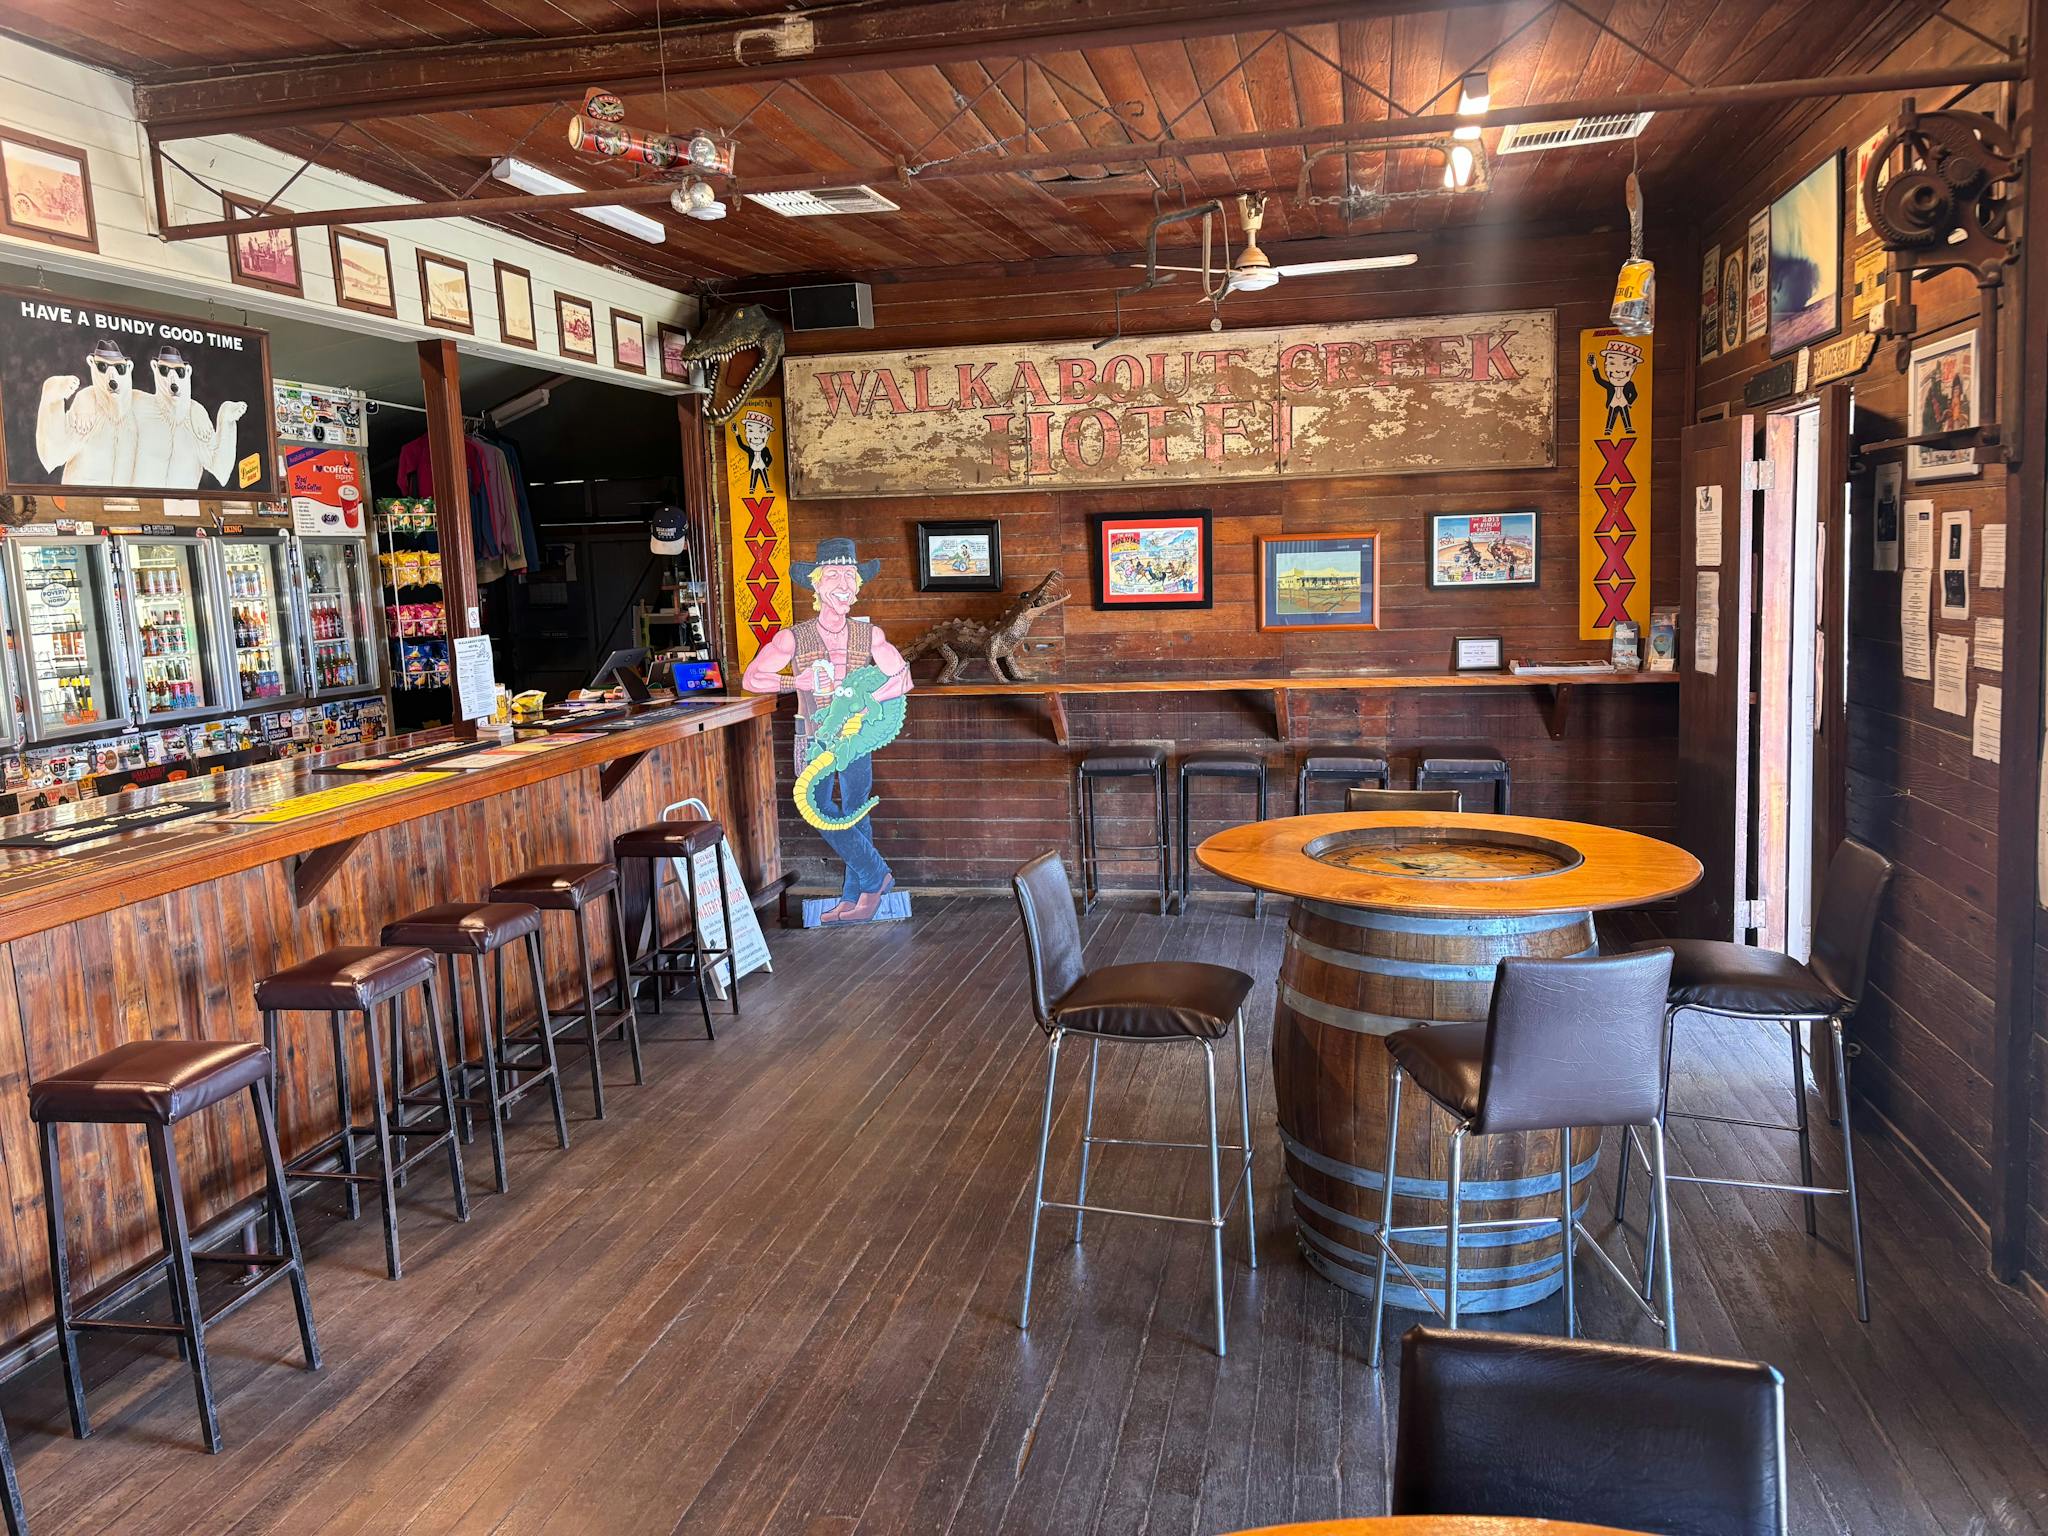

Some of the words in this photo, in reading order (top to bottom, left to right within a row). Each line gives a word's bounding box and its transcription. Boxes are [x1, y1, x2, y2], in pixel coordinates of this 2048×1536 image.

[21, 301, 72, 324] HAVE
[77, 310, 90, 327] A
[95, 313, 155, 336] BUNDY
[159, 324, 204, 344] GOOD
[206, 332, 244, 351] TIME
[1609, 341, 1640, 357] XXXX
[813, 350, 1247, 418] WALKABOUT
[1279, 330, 1524, 394] CREEK
[748, 412, 772, 425] XXXX
[983, 400, 1300, 477] HOTEL
[323, 464, 355, 475] coffee
[1593, 437, 1638, 629] XXXX
[42, 589, 68, 598] POVERTY
